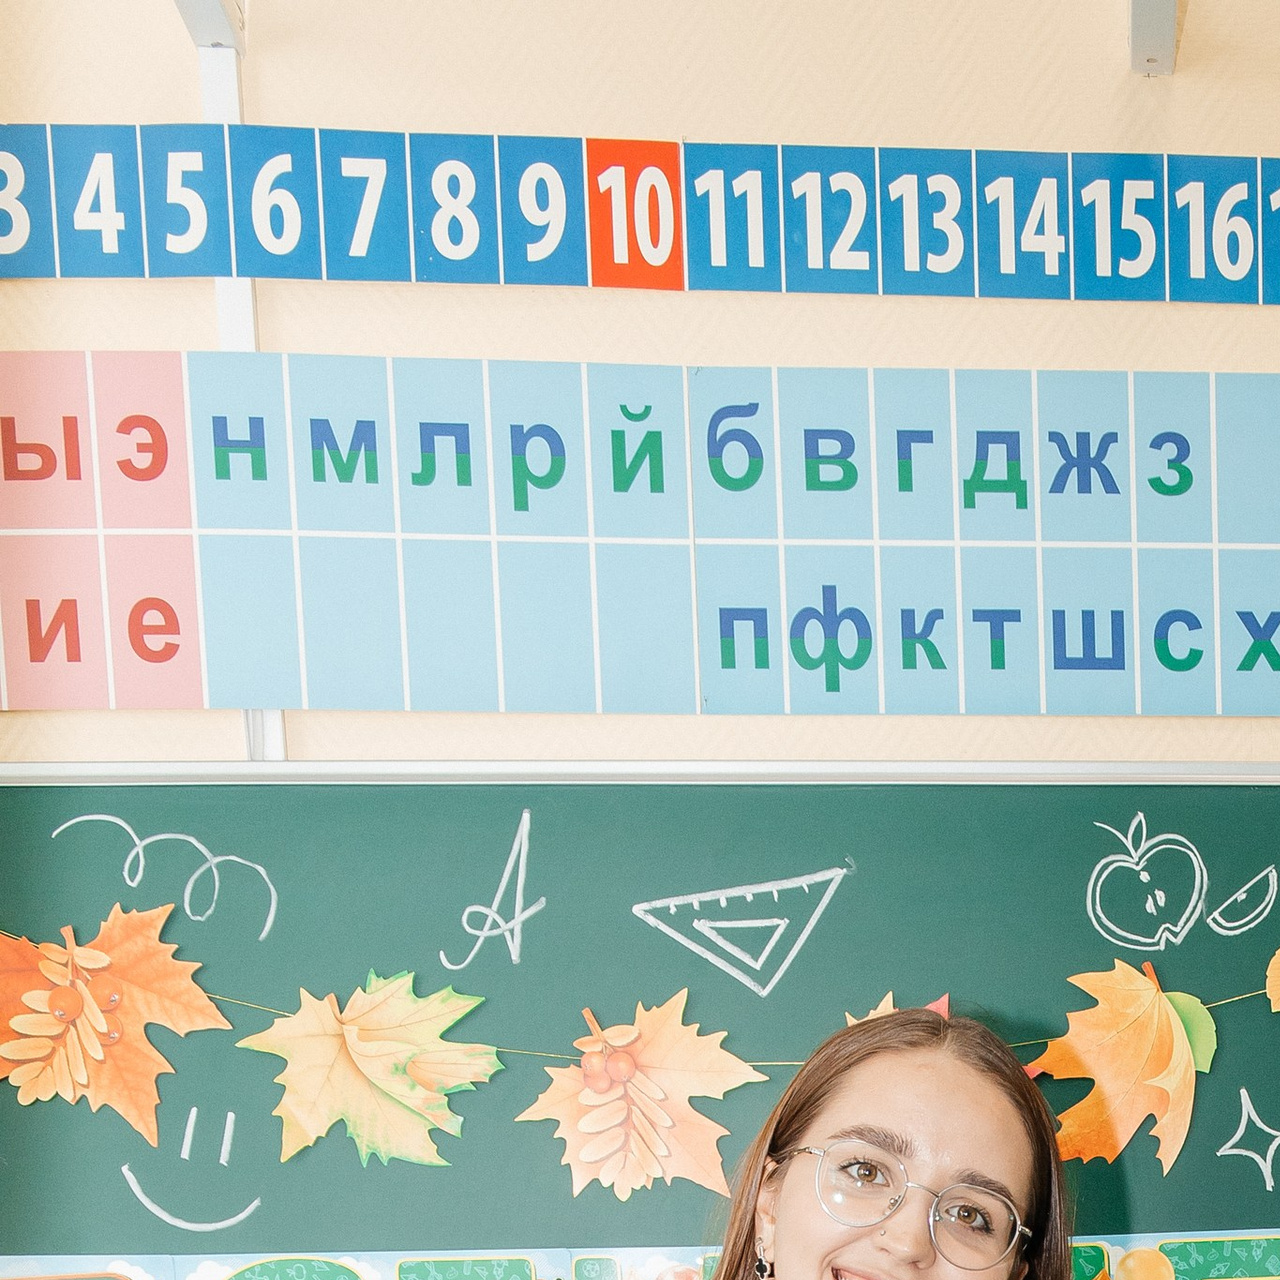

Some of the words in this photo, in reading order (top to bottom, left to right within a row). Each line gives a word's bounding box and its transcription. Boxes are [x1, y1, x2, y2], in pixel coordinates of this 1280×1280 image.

[74, 153, 125, 254] 4
[166, 152, 208, 254] 5
[252, 154, 302, 256] 6
[341, 157, 387, 257] 7
[431, 160, 480, 260] 8
[519, 162, 567, 262] 9
[598, 166, 674, 266] 10
[695, 170, 765, 268] 11
[792, 171, 870, 271] 12
[889, 174, 965, 273] 13
[985, 177, 1066, 275] 14
[1081, 180, 1157, 278] 15
[1176, 182, 1254, 280] 16
[0, 416, 82, 481] ы
[117, 415, 168, 482] э
[213, 416, 267, 481] н
[310, 420, 379, 484] м
[412, 423, 472, 487] л
[511, 424, 566, 512] р
[611, 404, 665, 493] й
[708, 402, 764, 492] б
[804, 429, 858, 492] в
[897, 430, 934, 493] г
[963, 431, 1028, 509] д
[1049, 432, 1121, 494] ж
[1148, 432, 1194, 496] з
[25, 599, 82, 664] и
[128, 597, 181, 663] е
[720, 608, 770, 669] п
[790, 585, 873, 692] ф
[901, 610, 946, 670] к
[972, 610, 1022, 670] т
[1053, 610, 1126, 671] ш
[1154, 610, 1204, 672] с
